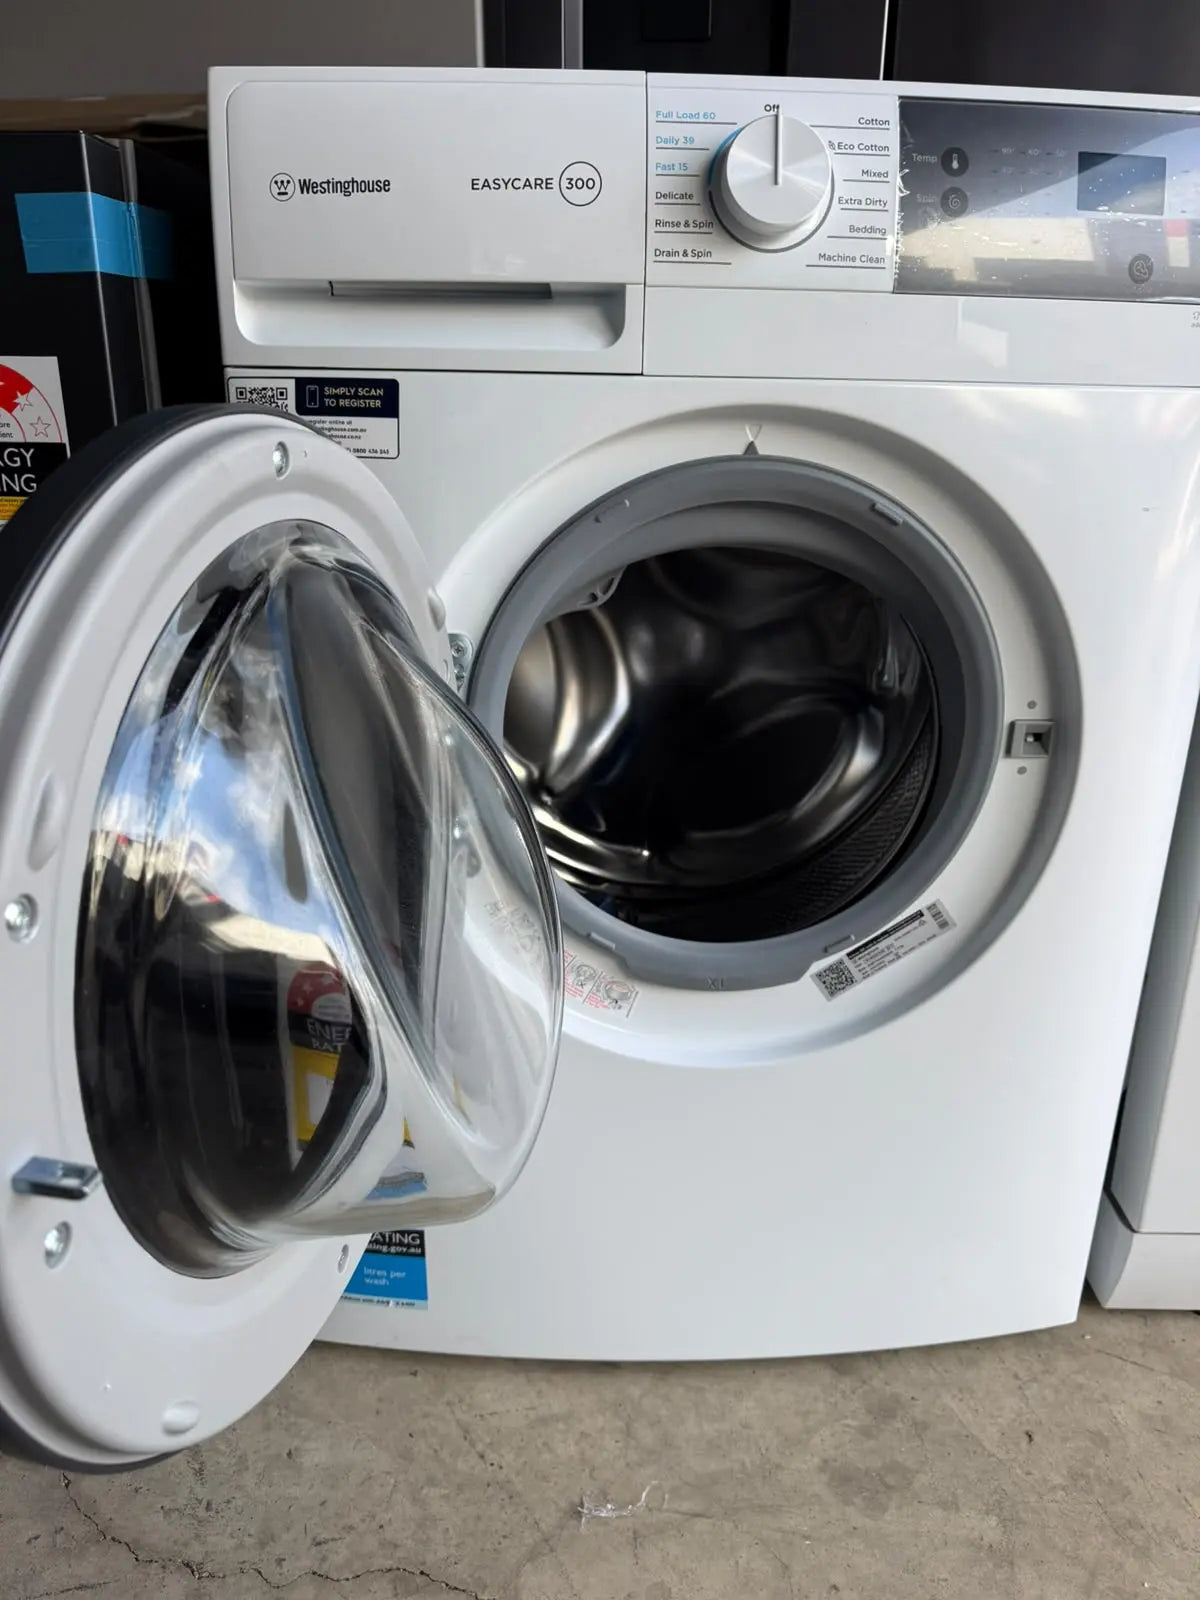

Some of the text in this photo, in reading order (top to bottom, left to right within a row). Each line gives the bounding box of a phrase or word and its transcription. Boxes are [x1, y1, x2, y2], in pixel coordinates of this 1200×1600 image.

[764, 103, 780, 113] Off
[655, 110, 717, 120] Full Load 60
[857, 116, 891, 126] Cotton
[655, 135, 696, 146] Daily 39
[836, 141, 891, 152] Eco Cotton
[911, 153, 938, 164] Temp
[655, 162, 689, 172] Fast 15
[861, 169, 890, 178] Mixed
[298, 176, 392, 198] Westinghouse
[470, 176, 597, 191] EASYCARE 300
[655, 191, 695, 201] Delicate
[837, 196, 889, 208] Extra Dirty
[654, 218, 715, 230] Rinse & Spin
[848, 224, 888, 236] Bedding
[653, 247, 713, 260] Drain & Spin
[818, 252, 886, 264] Machine Clean
[323, 386, 384, 396] SIMPLY SCAN
[323, 398, 382, 408] TO REGISTER
[0, 473, 38, 493] NG
[370, 1232, 421, 1245] ATING
